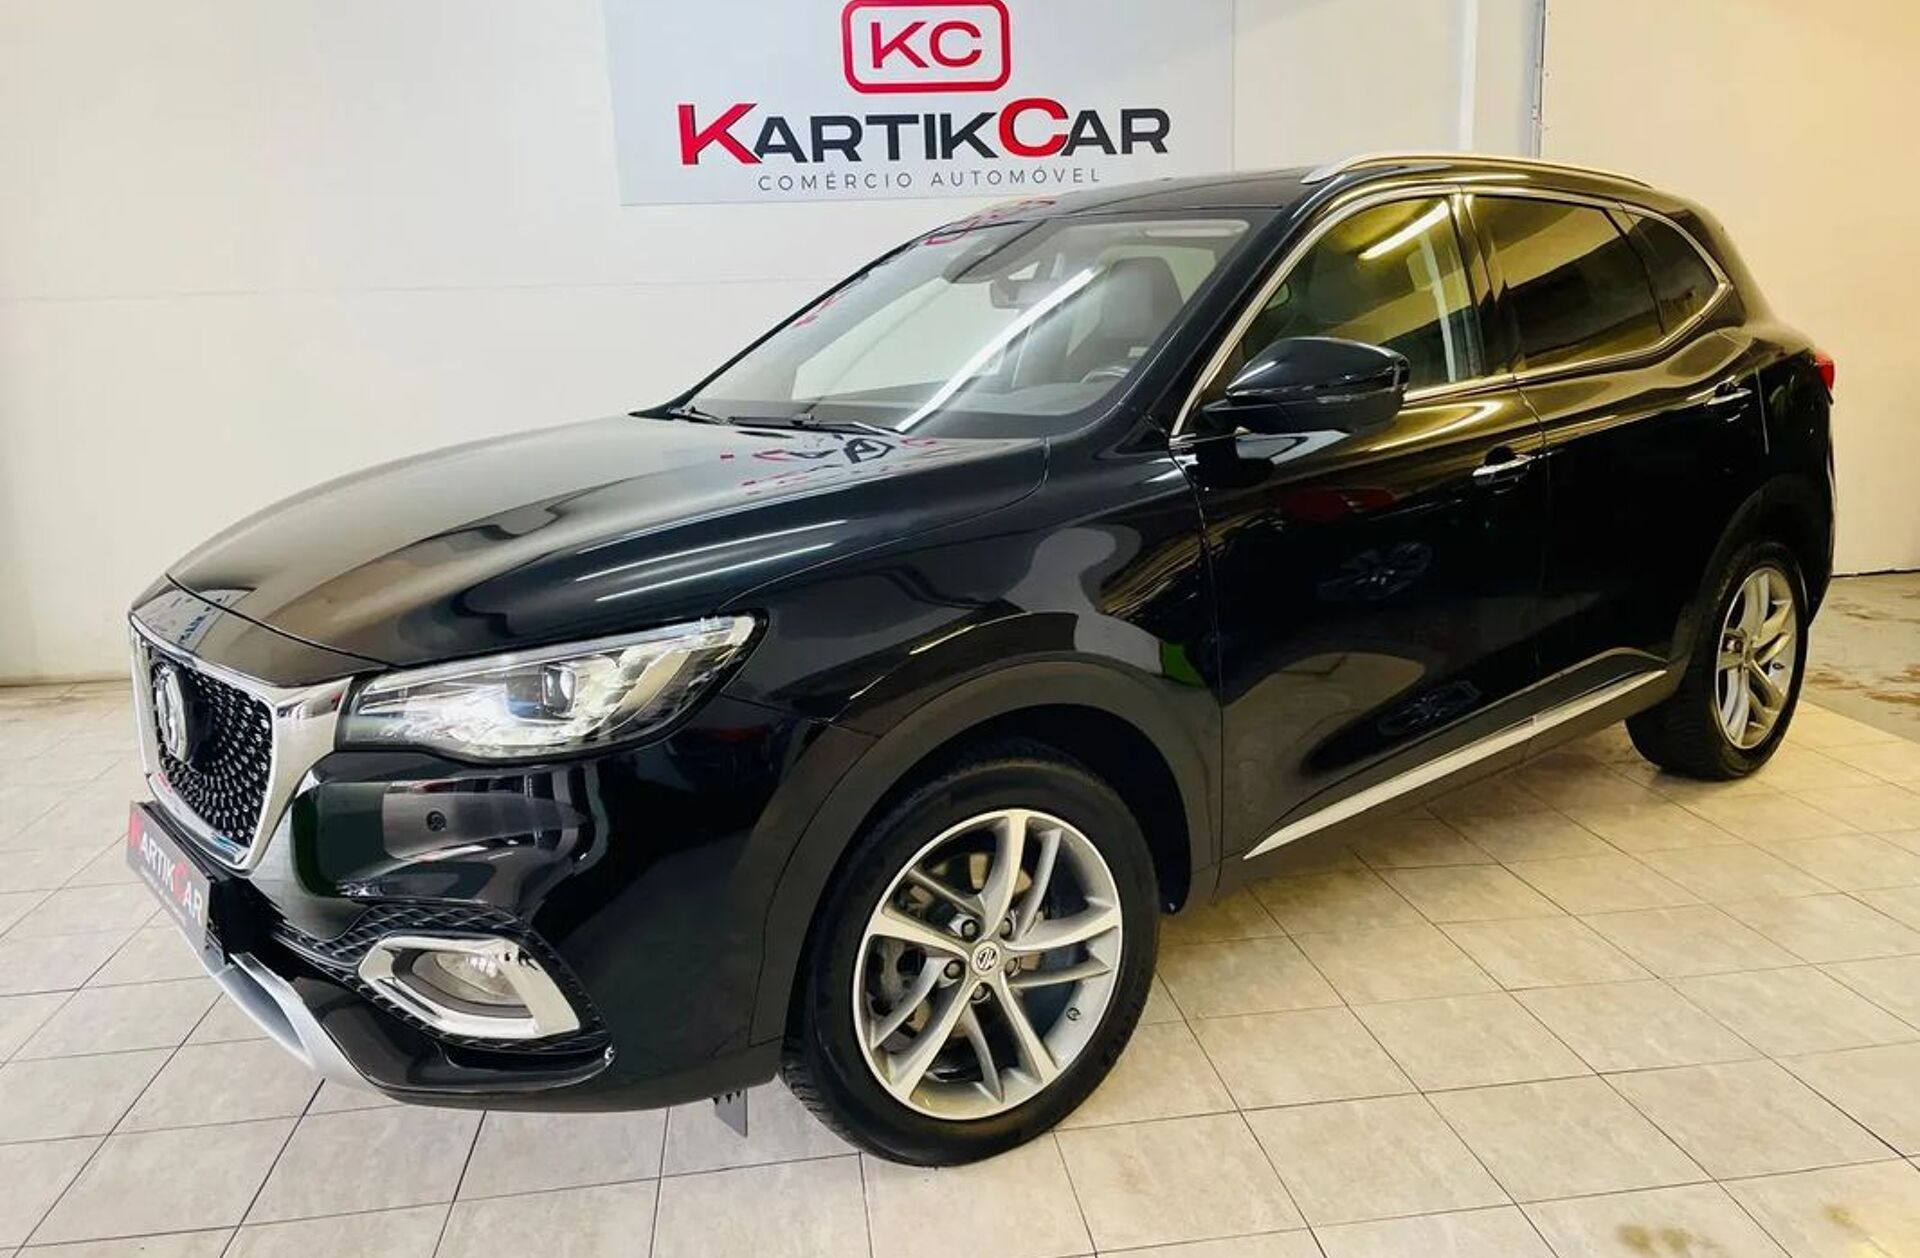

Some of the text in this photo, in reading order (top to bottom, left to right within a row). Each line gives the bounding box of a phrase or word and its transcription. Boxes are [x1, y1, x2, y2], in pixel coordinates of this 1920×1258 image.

[870, 21, 983, 69] KC
[758, 167, 1101, 191] COMÉRCIO AUTOMÓVEL
